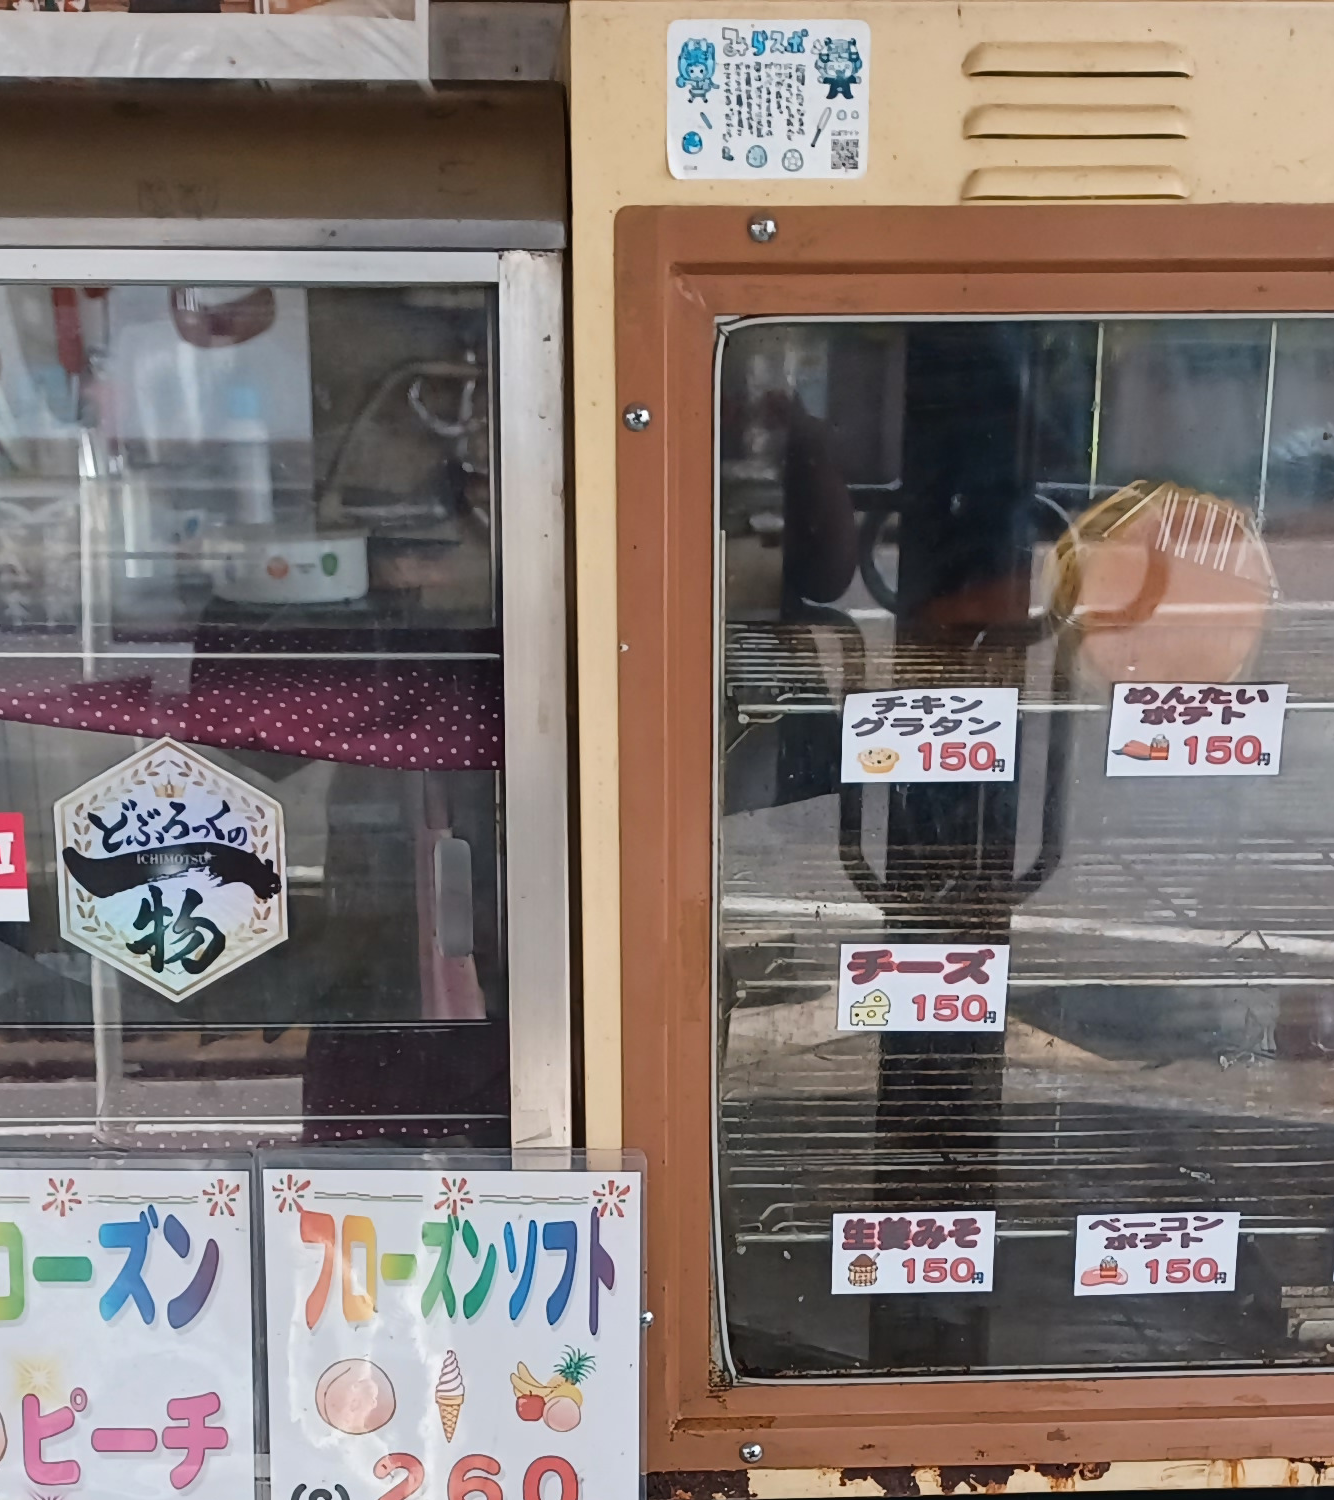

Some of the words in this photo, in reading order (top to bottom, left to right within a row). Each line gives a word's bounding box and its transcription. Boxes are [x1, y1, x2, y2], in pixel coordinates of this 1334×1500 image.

[872, 695, 983, 715] チキン
[1123, 686, 1269, 705] めんたい
[851, 716, 1001, 737] グラタン
[1140, 705, 1246, 725] ポテト
[917, 741, 1005, 772] 150円
[1183, 735, 1271, 766] 150円
[88, 799, 247, 853] どぶろっくの
[136, 852, 210, 866] ICHIMOTSU
[847, 948, 995, 985] チーズ
[912, 994, 996, 1023] 150円
[1088, 1216, 1224, 1232] ベーコン
[1104, 1232, 1204, 1250] ポテト
[299, 1206, 615, 1336] フローズンソフト
[902, 1257, 984, 1284] 150円
[1145, 1257, 1227, 1285] 150円
[22, 1387, 229, 1490] ピーチ
